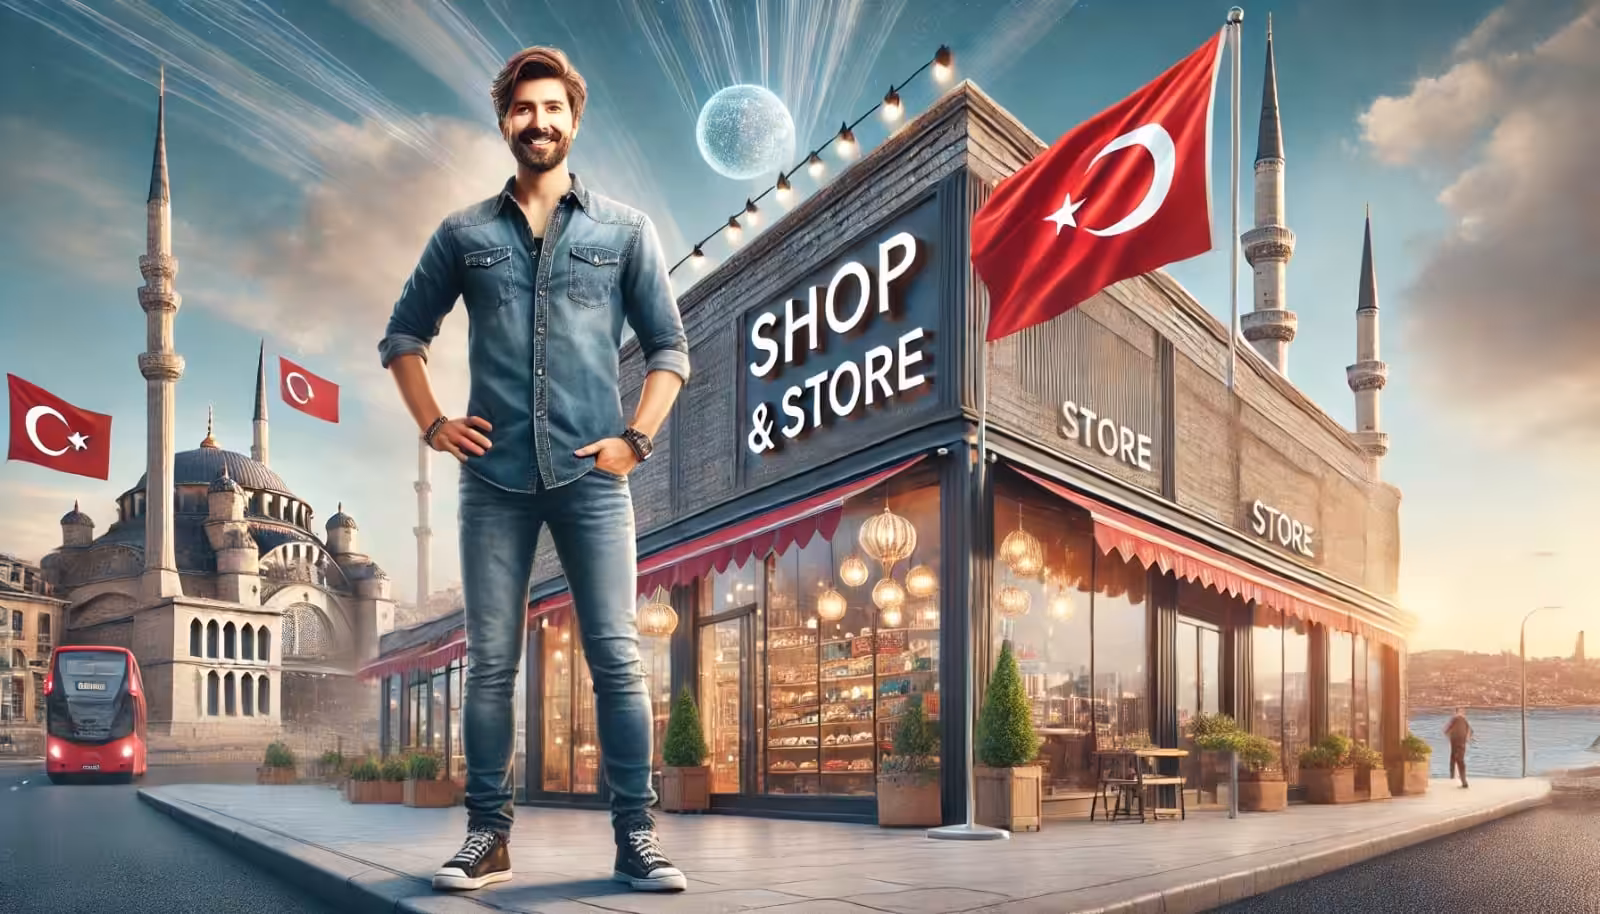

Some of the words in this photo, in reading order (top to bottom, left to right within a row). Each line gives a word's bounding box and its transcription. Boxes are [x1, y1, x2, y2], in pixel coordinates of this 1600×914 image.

[750, 232, 917, 377] SHOP
[748, 403, 775, 454] &
[781, 328, 925, 438] STORE
[1062, 400, 1152, 471] STORE
[1252, 499, 1314, 558] STORE
